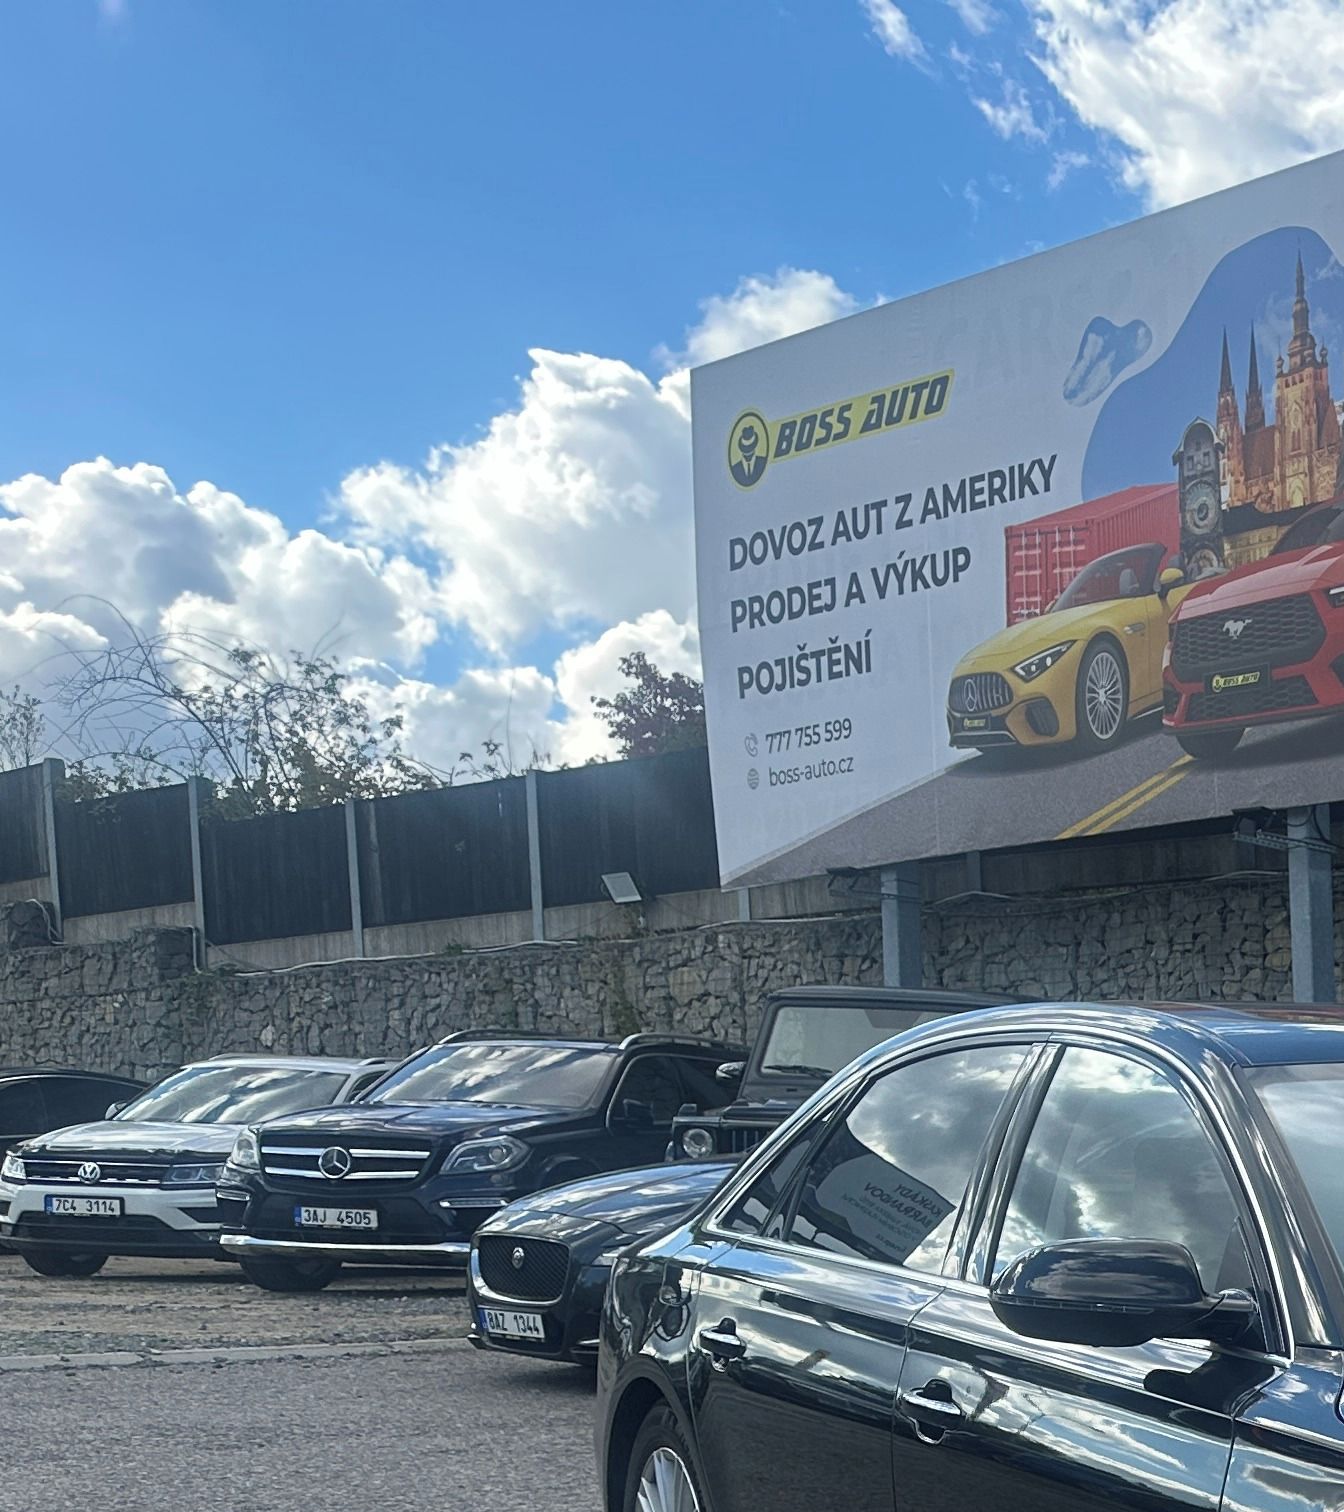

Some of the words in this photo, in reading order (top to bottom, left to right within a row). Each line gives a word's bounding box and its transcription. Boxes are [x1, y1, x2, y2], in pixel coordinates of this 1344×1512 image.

[773, 402, 853, 459] BOSS
[859, 375, 950, 434] AUTO
[729, 515, 825, 571] DOVOZ
[831, 499, 888, 547] AUT
[895, 497, 914, 531] Z
[920, 454, 1058, 524] AMERIKY
[730, 577, 838, 633] PRODEJ
[844, 571, 866, 608] A
[870, 546, 971, 600] VÝKUP
[737, 628, 873, 699] POJIŠTĚNÍ
[765, 730, 792, 754] 777
[795, 724, 821, 748] 755
[824, 718, 852, 742] 599
[769, 757, 854, 786] boss-auto.cz
[55, 1199, 76, 1212] 7C4
[86, 1200, 115, 1213] 3114
[304, 1209, 327, 1223] 3AJ
[337, 1211, 371, 1225] 4505
[513, 1314, 539, 1335] 1344
